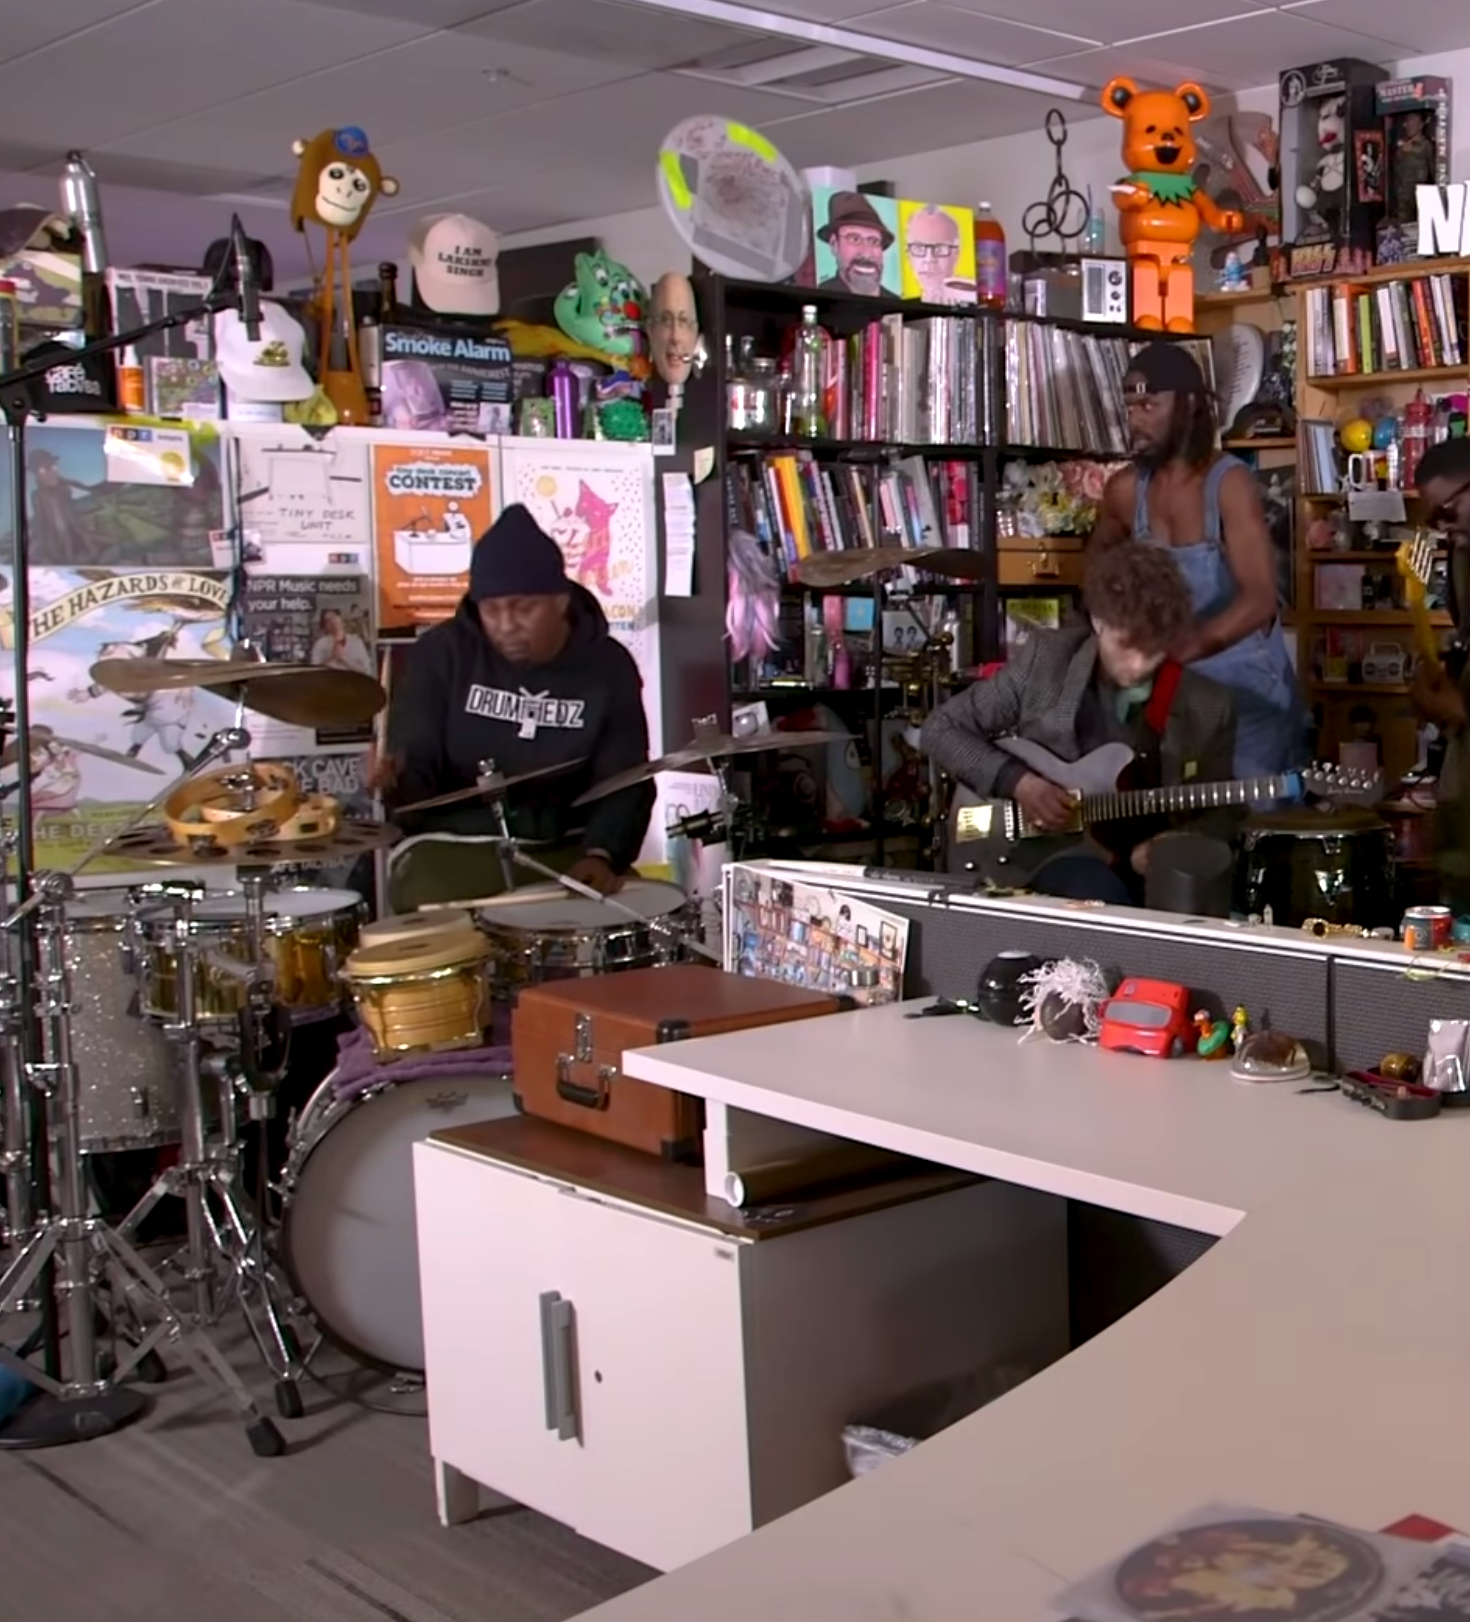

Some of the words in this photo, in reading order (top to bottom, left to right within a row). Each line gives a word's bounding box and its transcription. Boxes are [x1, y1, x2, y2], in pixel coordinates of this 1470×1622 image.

[463, 247, 481, 256] AM
[446, 264, 484, 277] SINGH
[385, 332, 450, 354] Smoke
[453, 338, 511, 362] Alarm
[389, 474, 477, 491] CONTEST
[278, 508, 314, 519] TINY
[322, 510, 356, 520] DESK
[247, 580, 277, 592] NPR
[279, 580, 316, 592] Music
[319, 582, 357, 592] needs
[32, 607, 66, 637] HE
[69, 574, 170, 617] HAZARDS
[249, 599, 279, 612] your
[281, 597, 313, 610] help.
[311, 760, 360, 779] CAVE
[322, 777, 359, 793] BAD
